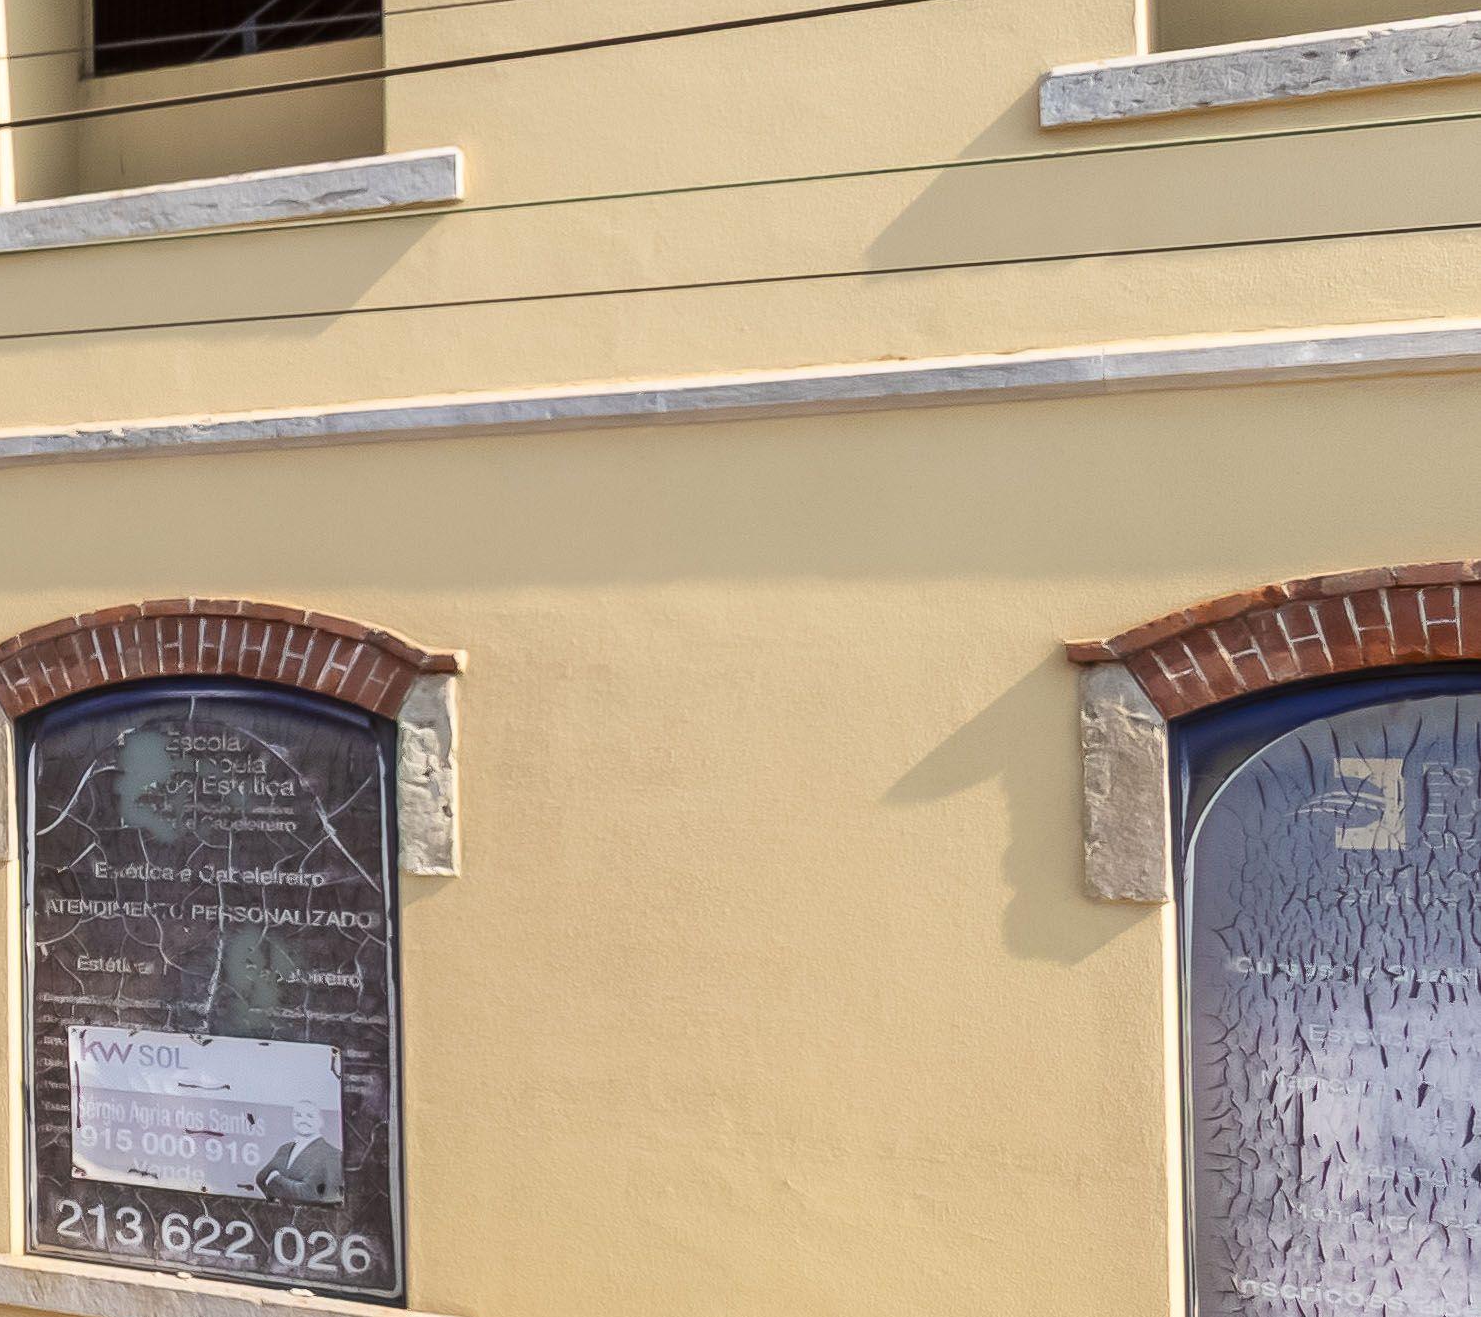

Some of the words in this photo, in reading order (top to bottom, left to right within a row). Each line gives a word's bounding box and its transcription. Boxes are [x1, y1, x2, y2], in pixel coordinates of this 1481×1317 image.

[191, 904, 373, 929] PERSONALIZADO
[138, 1044, 189, 1070] SOL
[175, 1105, 205, 1130] dos
[79, 1125, 134, 1153] 915
[140, 1131, 196, 1160] 000
[205, 1137, 260, 1166] 916
[56, 1199, 145, 1247] 213
[160, 1212, 256, 1260] 622
[273, 1226, 372, 1275] 026
